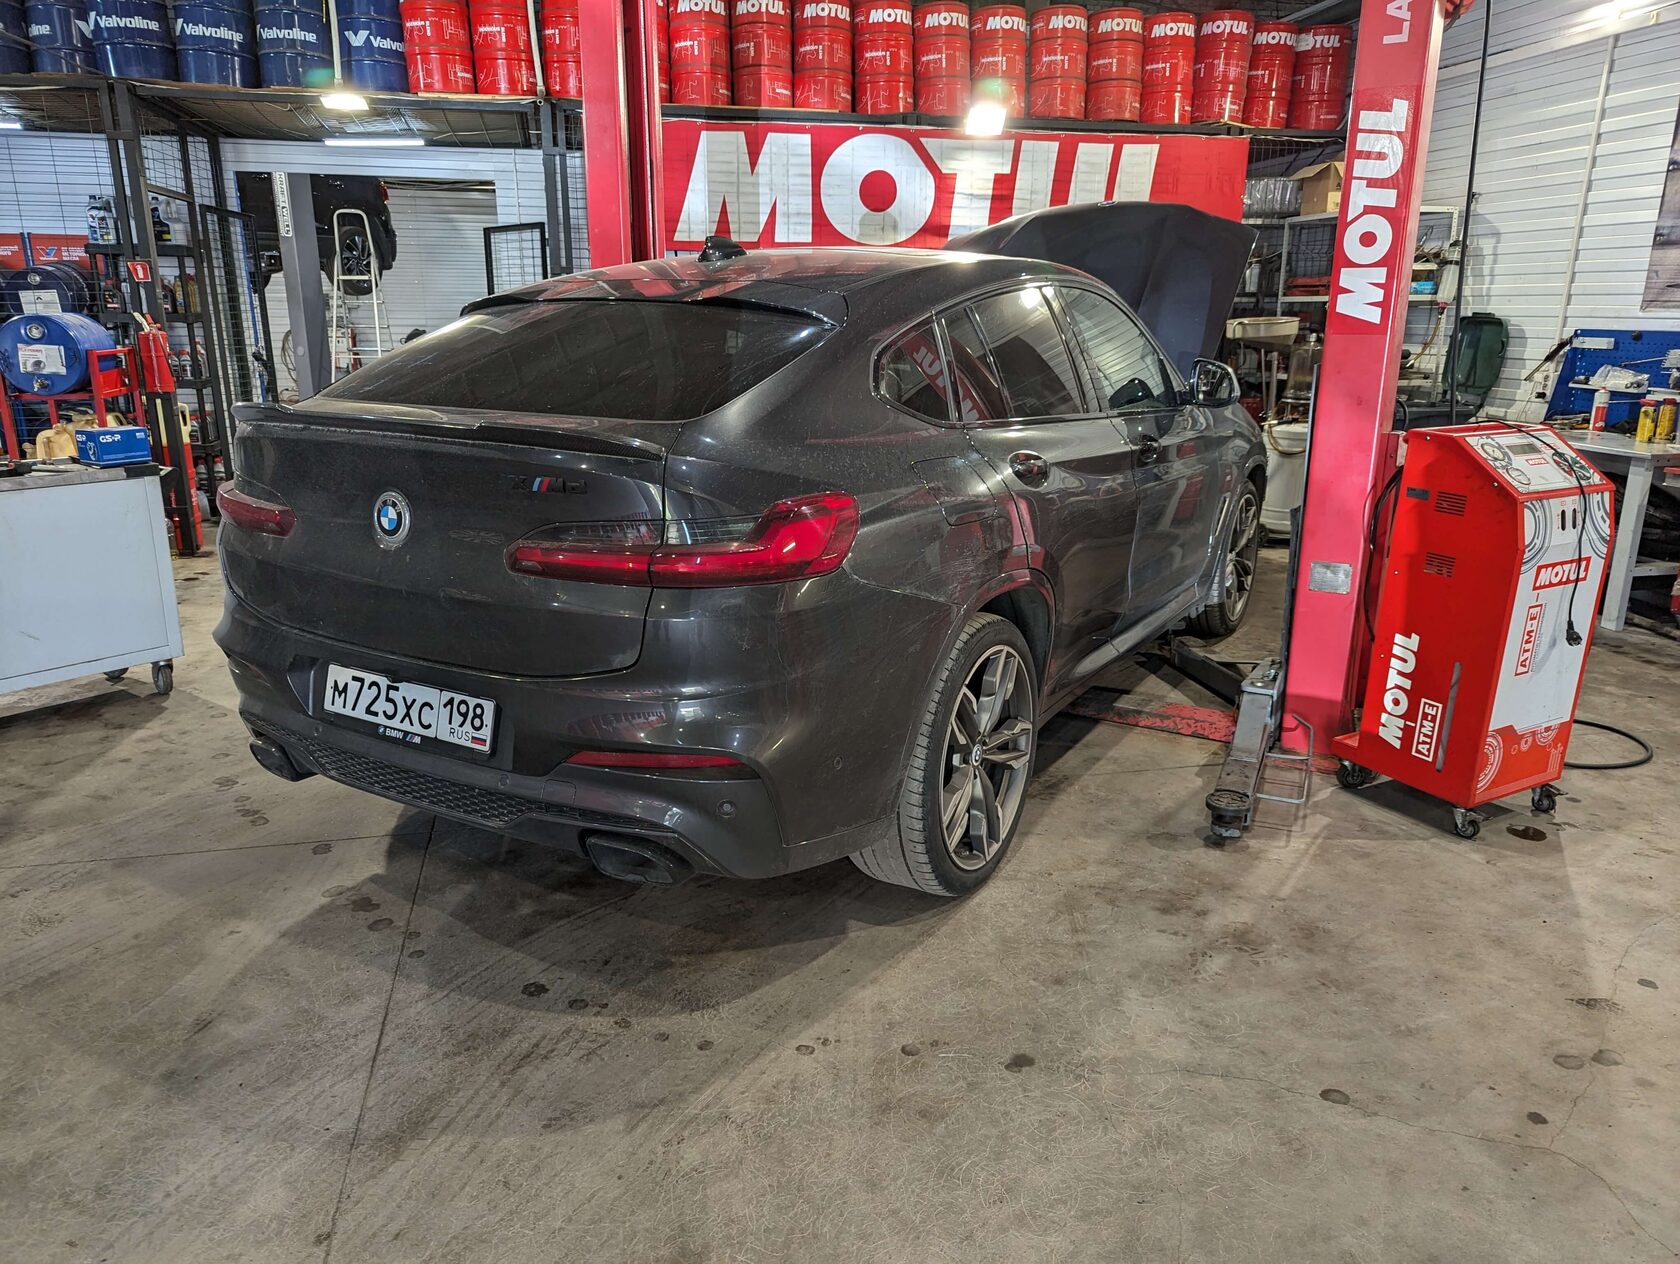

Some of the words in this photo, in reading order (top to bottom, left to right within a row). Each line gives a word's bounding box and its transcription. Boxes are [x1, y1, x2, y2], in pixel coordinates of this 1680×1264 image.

[677, 0, 726, 16] MOTUL
[736, 0, 785, 16] MOTUL
[803, 3, 850, 21] MOTUL
[97, 15, 161, 31] Valvoline
[986, 15, 1026, 32] MOTU
[1049, 15, 1087, 33] MOTU
[1200, 20, 1248, 36] MOTUL
[183, 22, 244, 43] Valvoline
[260, 27, 317, 43] Valvoline
[369, 35, 405, 52] Valvol
[1335, 98, 1409, 325] MOTUL
[1535, 560, 1587, 587] MOTUL
[1520, 610, 1538, 668] ATM-E
[1378, 632, 1420, 750] MOTUL
[443, 696, 485, 732] 198
[385, 728, 404, 739] BMW
[449, 727, 471, 742] RUS
[1418, 704, 1437, 755] ATM-E
